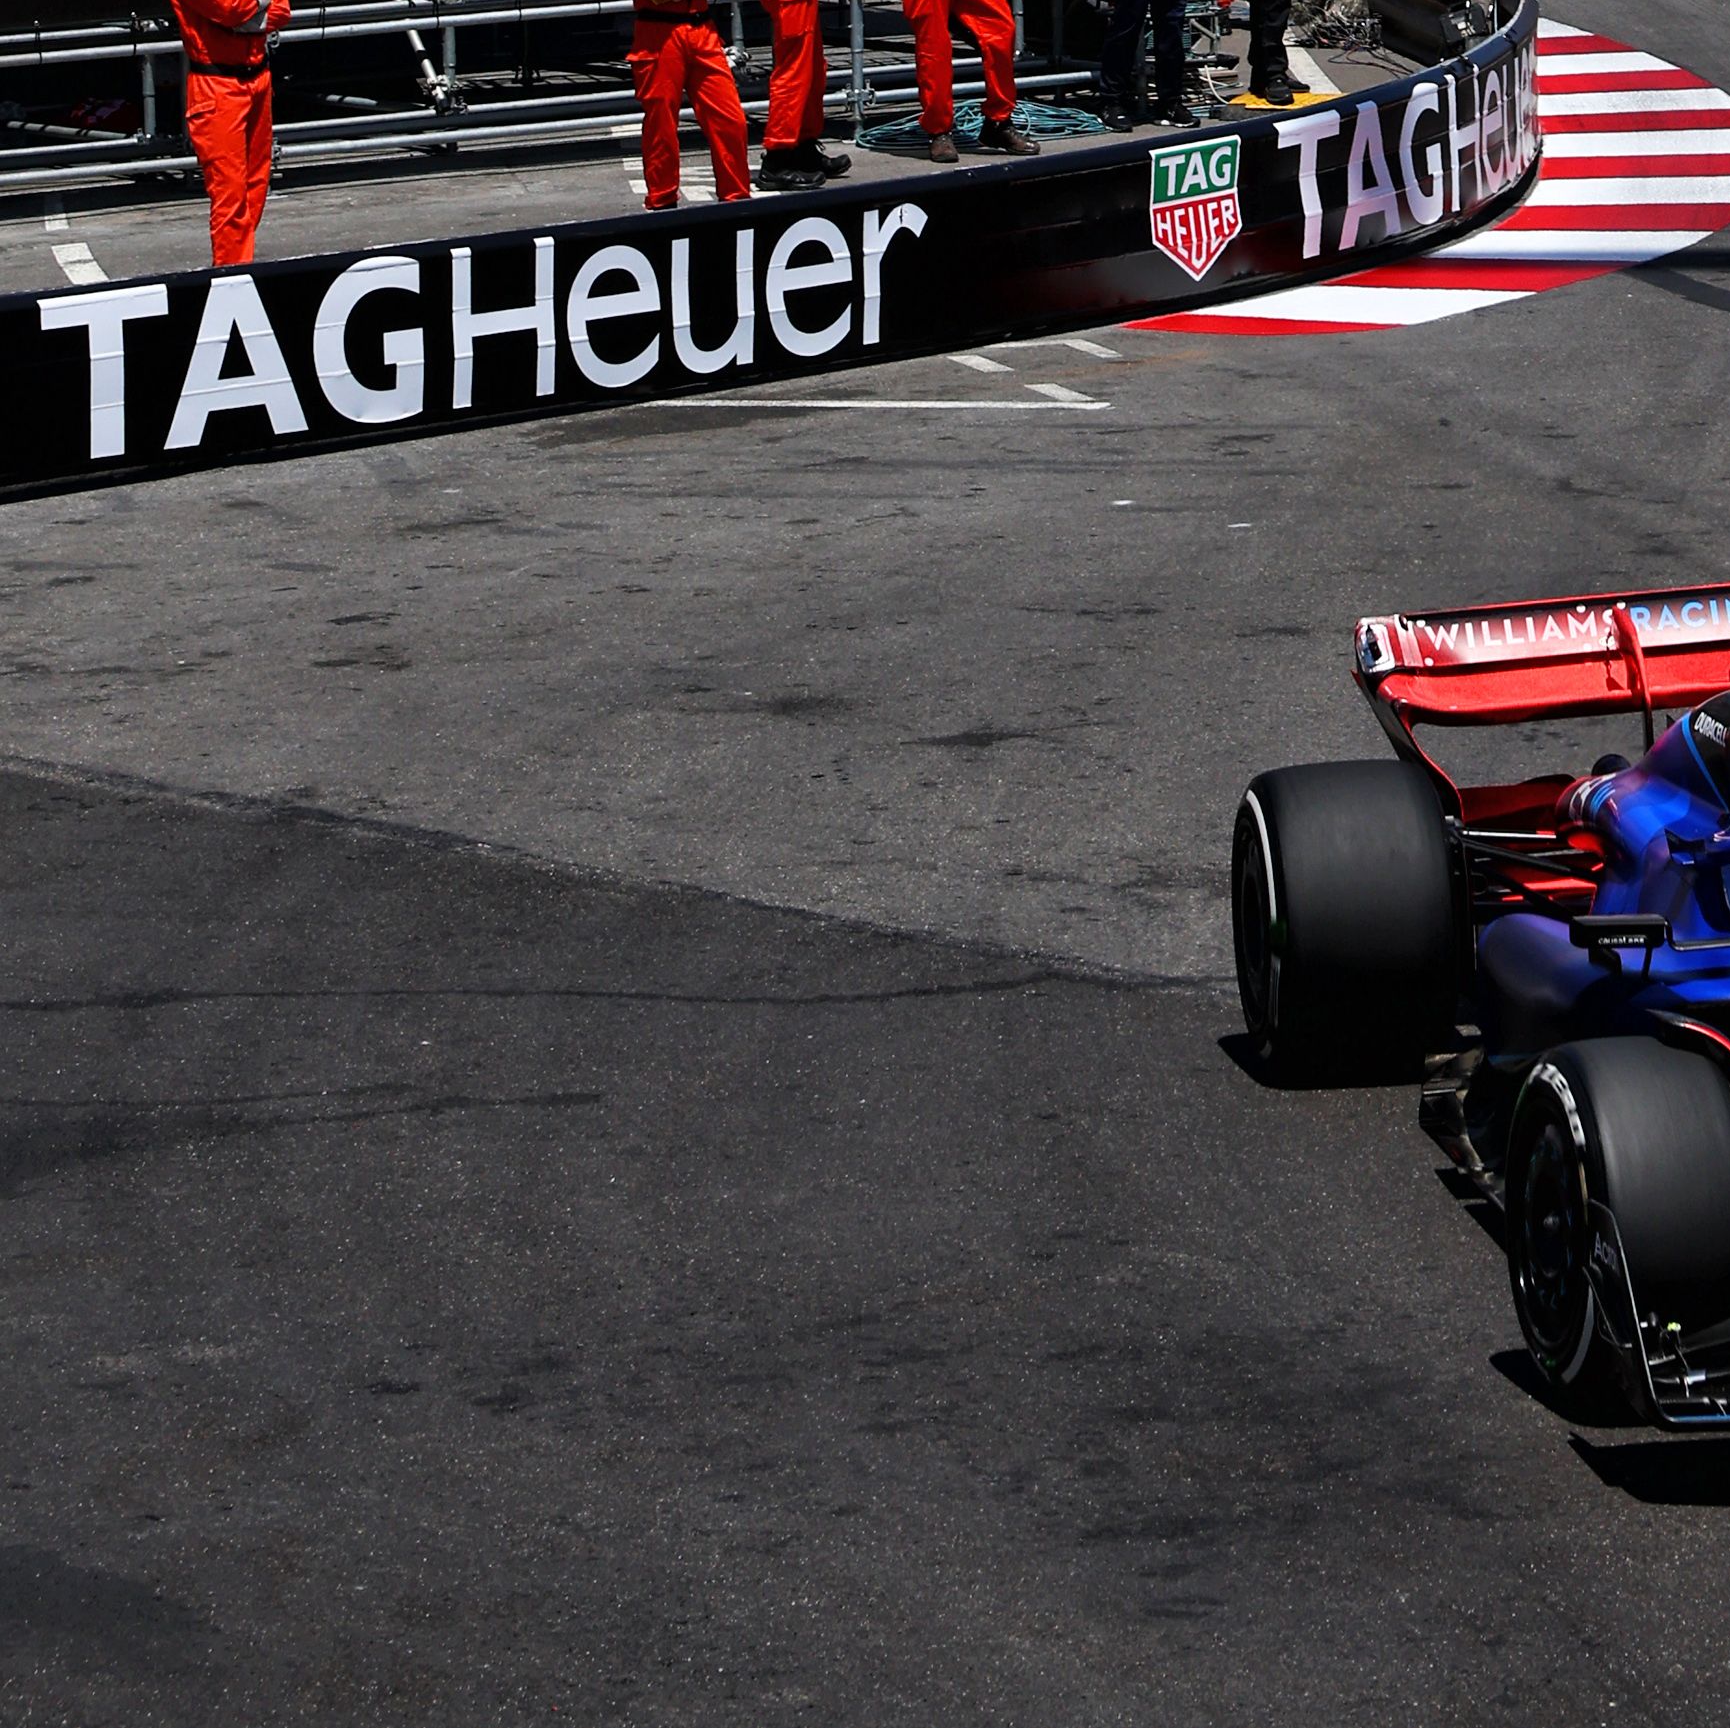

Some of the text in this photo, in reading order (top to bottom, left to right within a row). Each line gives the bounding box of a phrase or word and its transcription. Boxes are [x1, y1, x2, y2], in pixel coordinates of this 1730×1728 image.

[1158, 145, 1232, 197] TAG
[1155, 198, 1237, 268] HEUER
[1422, 609, 1615, 653] WILLIAMS
